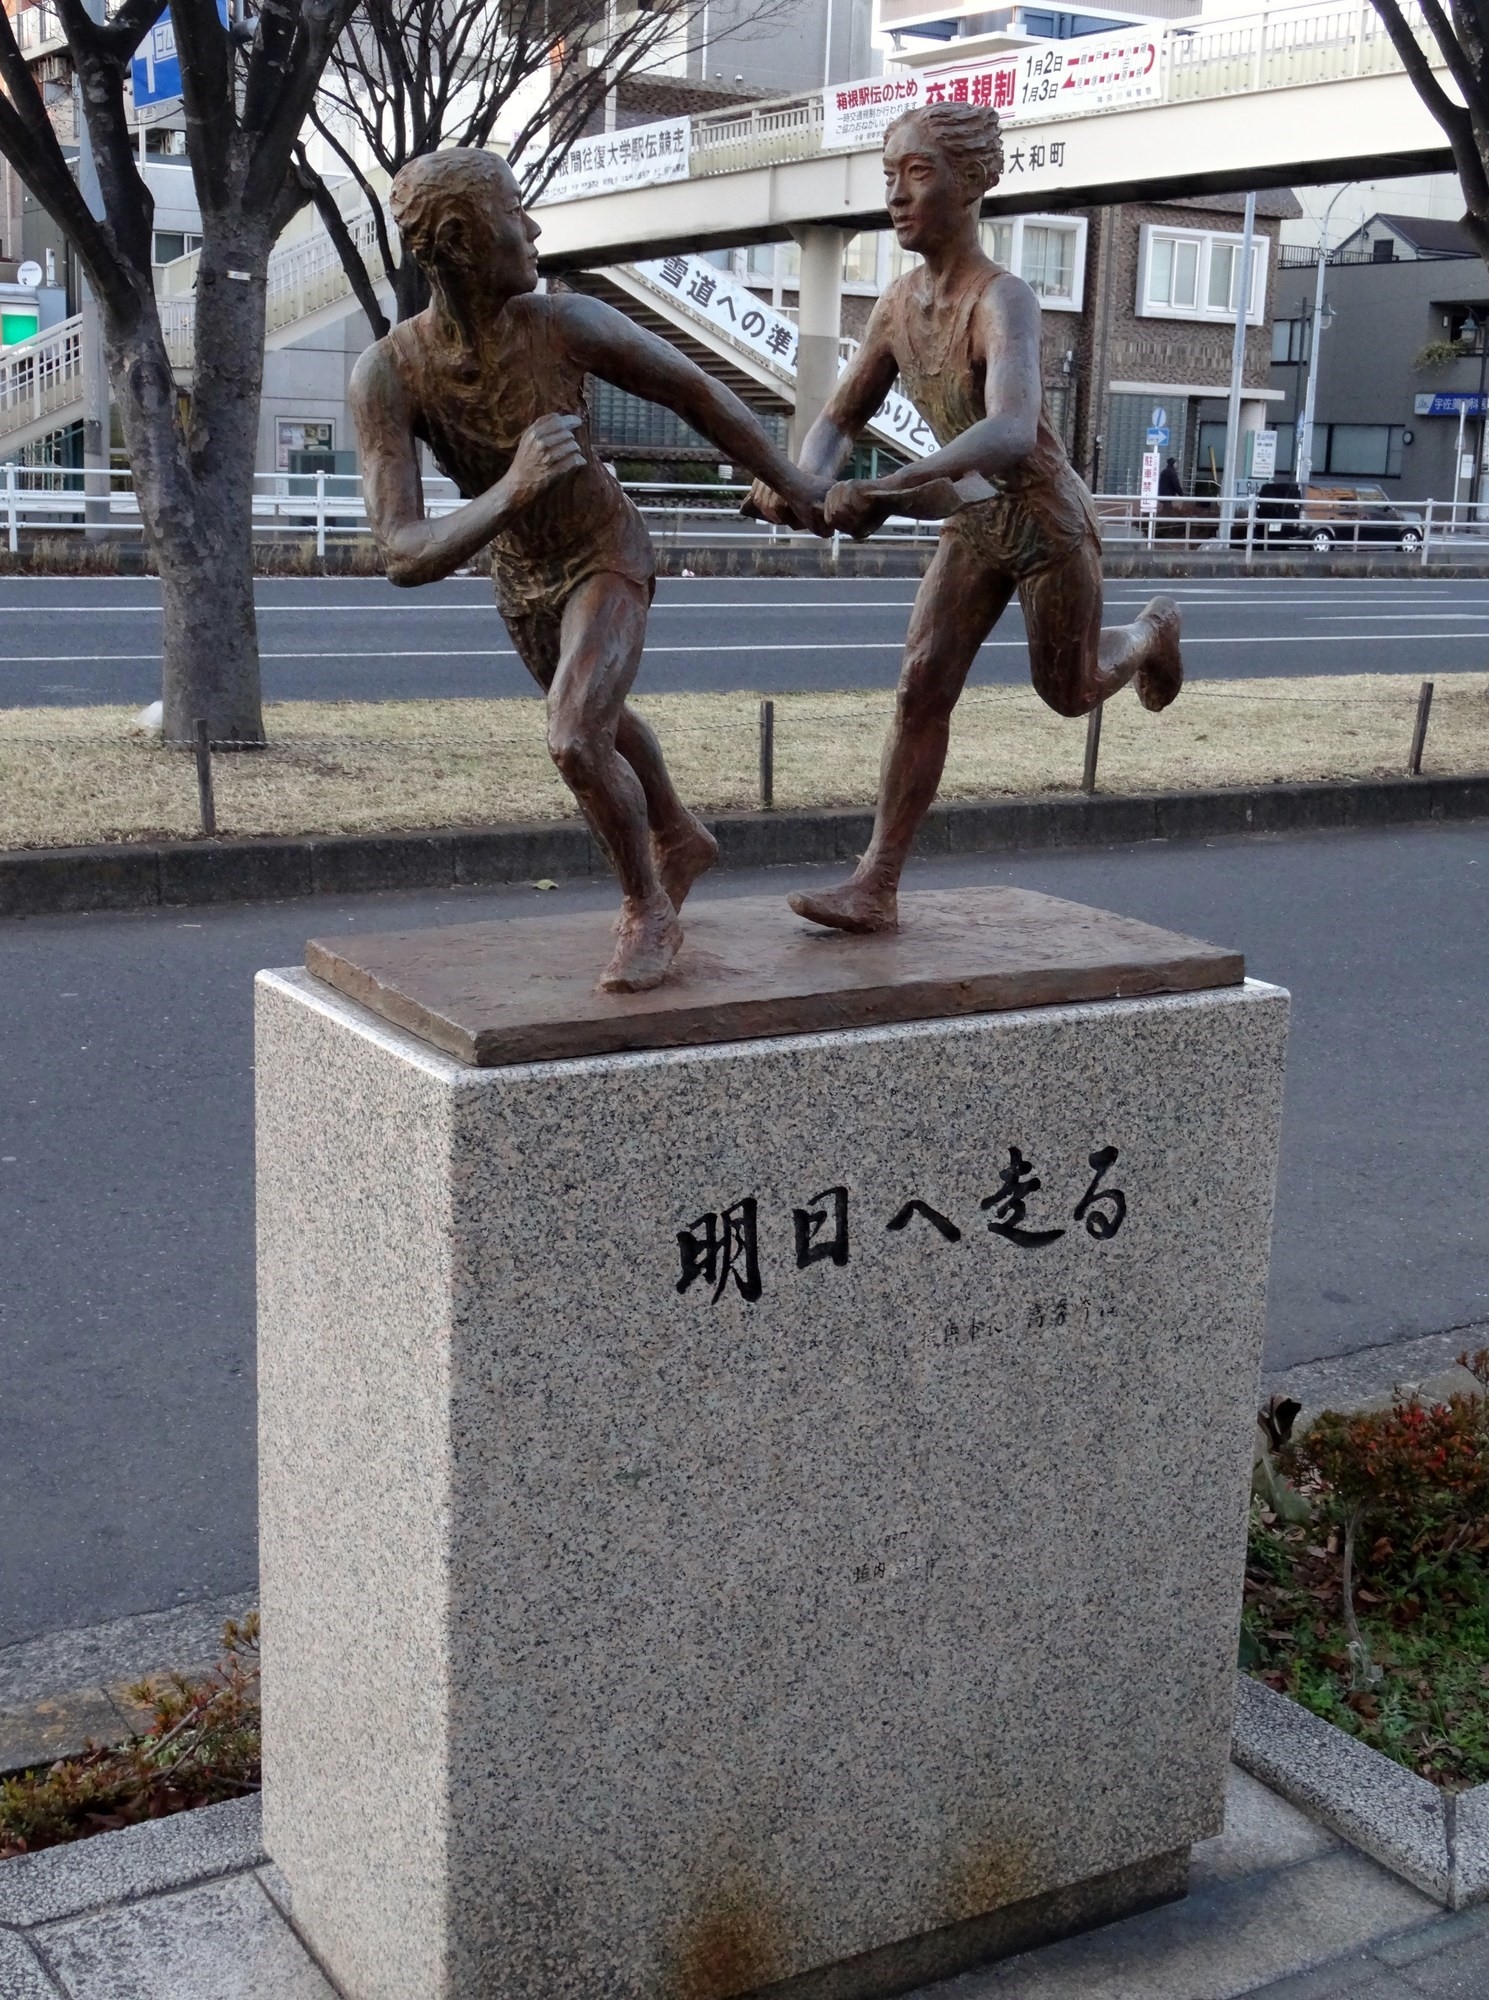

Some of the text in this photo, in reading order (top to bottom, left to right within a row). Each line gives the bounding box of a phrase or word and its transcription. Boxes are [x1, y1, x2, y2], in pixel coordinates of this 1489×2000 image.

[1026, 51, 1064, 78] 1月2日
[836, 78, 919, 111] 箱根駅伝のため
[925, 68, 1016, 109] 交通規制
[1022, 78, 1059, 104] 1月3日
[835, 117, 896, 135] ご協力おねがいい
[524, 127, 685, 184] 東根間往復大学駅伝競走
[999, 142, 1066, 174] 大和町
[658, 255, 799, 369] 雪道への準
[675, 1146, 1128, 1305] 明日へ走る
